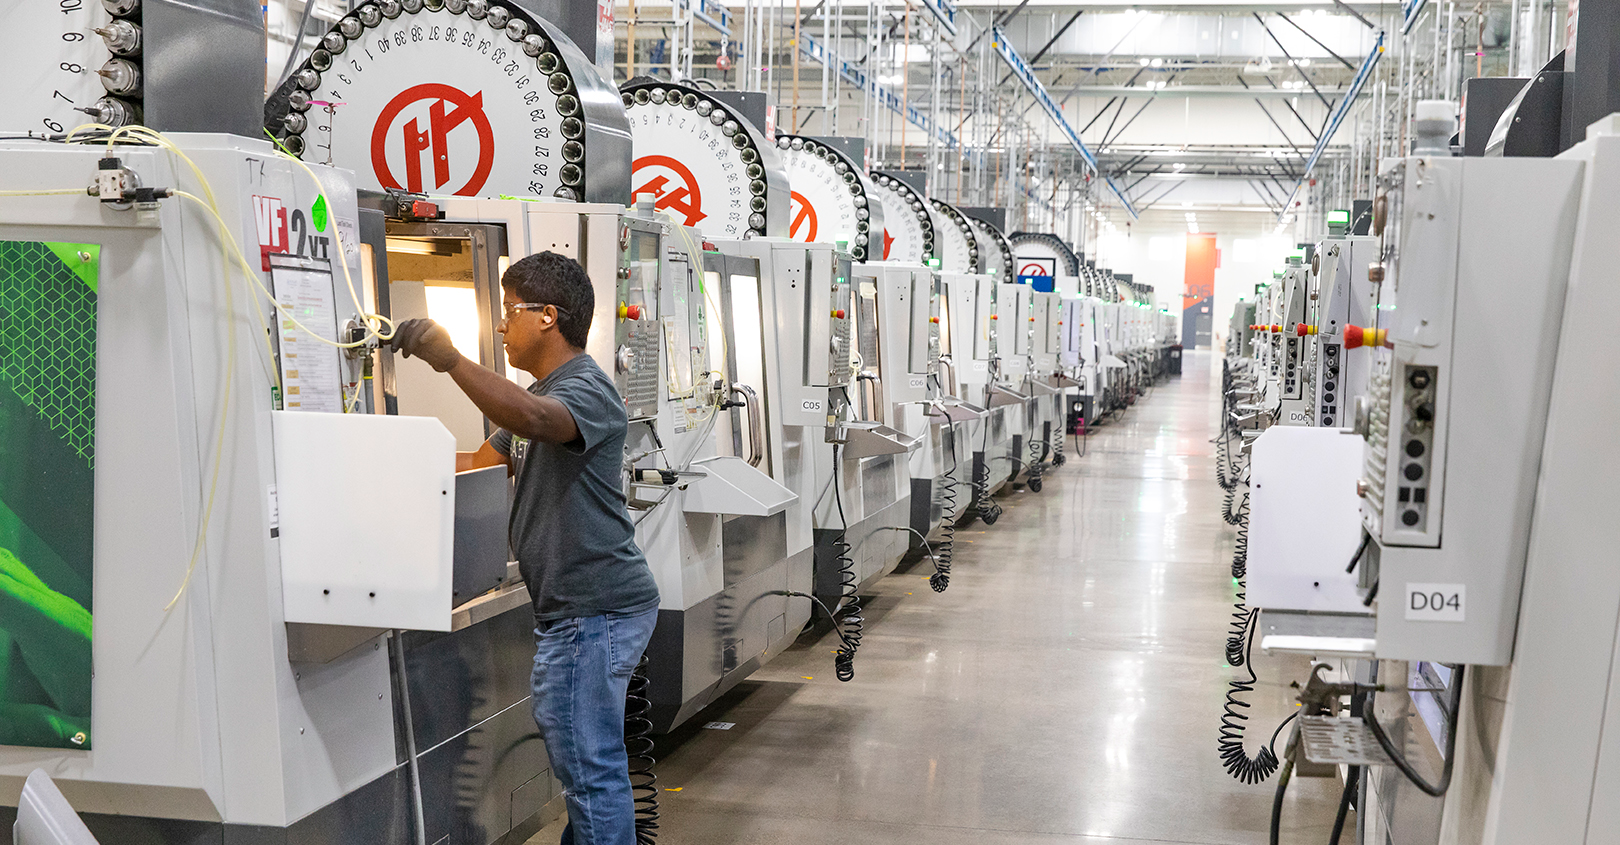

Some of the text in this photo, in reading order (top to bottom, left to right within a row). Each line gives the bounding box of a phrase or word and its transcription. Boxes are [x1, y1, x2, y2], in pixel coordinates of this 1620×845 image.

[62, 32, 84, 42] 9
[394, 30, 407, 46] 39
[410, 26, 424, 42] 38
[428, 26, 440, 41] 37
[445, 27, 457, 43] 36
[462, 31, 475, 48] 35
[377, 38, 390, 53] 40
[477, 38, 491, 55] 34
[365, 49, 374, 61] 1
[491, 47, 507, 64] 33
[60, 62, 81, 73] 8
[350, 59, 362, 72] 2
[503, 60, 519, 77] 32
[339, 74, 352, 85] 3
[514, 74, 530, 89] 31
[53, 90, 74, 104] 7
[330, 90, 342, 100] 4
[523, 90, 539, 106] 30
[530, 108, 546, 123] 29
[642, 115, 648, 125] 5
[656, 114, 660, 124] 4
[668, 114, 673, 126] 3
[43, 118, 63, 133] 6
[679, 118, 686, 129] 2
[690, 124, 696, 133] 1
[534, 126, 549, 140] 28
[698, 130, 709, 141] 40
[535, 145, 549, 158] 27
[533, 163, 548, 176] 26
[722, 161, 734, 171] 37
[727, 172, 738, 183] 36
[528, 180, 544, 195] 25
[730, 186, 740, 196] 35
[730, 200, 741, 208] 34
[728, 212, 741, 222] 33
[252, 194, 283, 247] VF
[292, 208, 306, 256] 2
[725, 224, 737, 235] 32
[802, 401, 820, 410] C05
[1290, 413, 1307, 421] D06
[1411, 592, 1460, 612] D04
